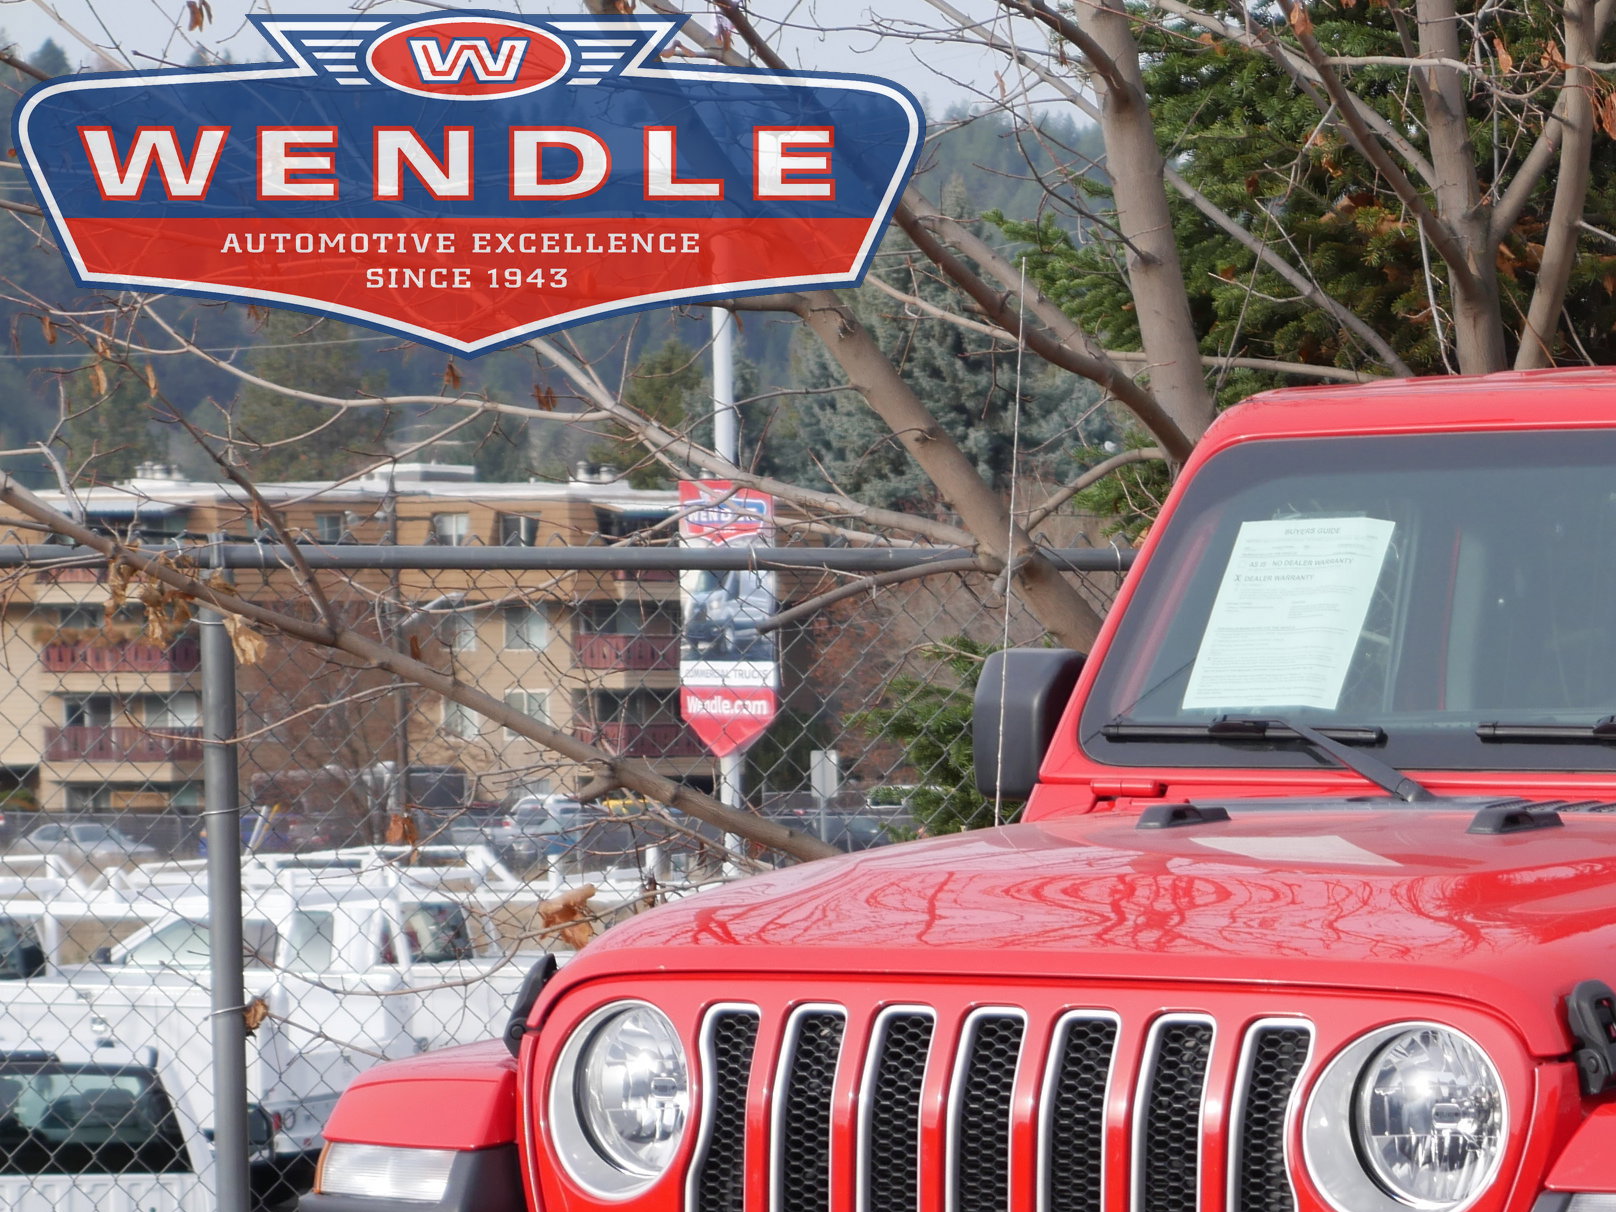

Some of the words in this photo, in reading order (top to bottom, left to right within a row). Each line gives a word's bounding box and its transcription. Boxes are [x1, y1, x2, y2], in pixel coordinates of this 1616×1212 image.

[1284, 527, 1315, 536] BUYERS
[1317, 527, 1341, 535] GUIDE
[1284, 559, 1313, 567] DEALER
[1314, 558, 1353, 566] WARRANTY
[1244, 574, 1272, 582] DEALER
[687, 695, 768, 715] Wendle.com
